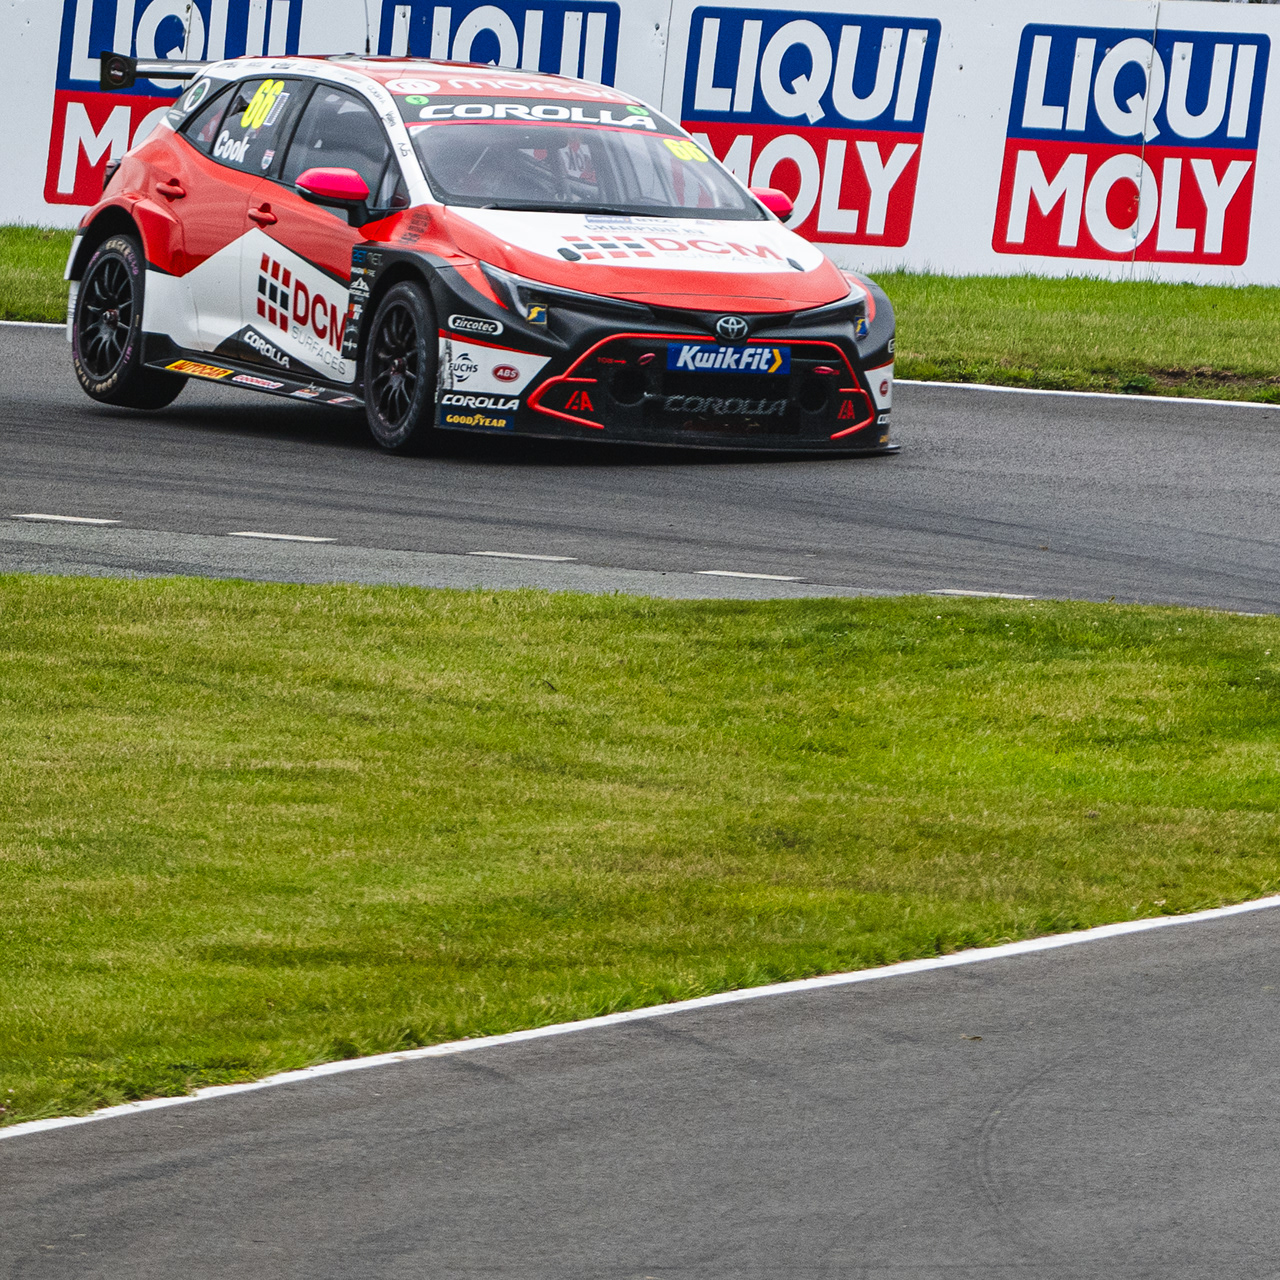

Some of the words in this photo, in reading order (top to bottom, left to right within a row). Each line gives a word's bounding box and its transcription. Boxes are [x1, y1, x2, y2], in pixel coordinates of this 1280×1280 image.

[694, 17, 929, 125] LIQUI
[1022, 35, 1258, 143] LIQUI
[241, 79, 285, 129] 66
[419, 103, 658, 130] COROLLA
[212, 130, 250, 163] Cook
[663, 138, 709, 163] 66
[1006, 150, 1252, 253] MOLY
[642, 237, 784, 261] DCM
[292, 279, 348, 351] DCM
[454, 317, 496, 332] zircotec
[243, 331, 290, 368] COROLLA
[290, 324, 346, 374] SURFACES
[170, 360, 229, 379] AUTOCAR
[448, 362, 478, 373] FUCHS
[497, 369, 517, 379] ABS
[441, 394, 520, 410] COROLLA
[663, 395, 789, 417] COROLLA
